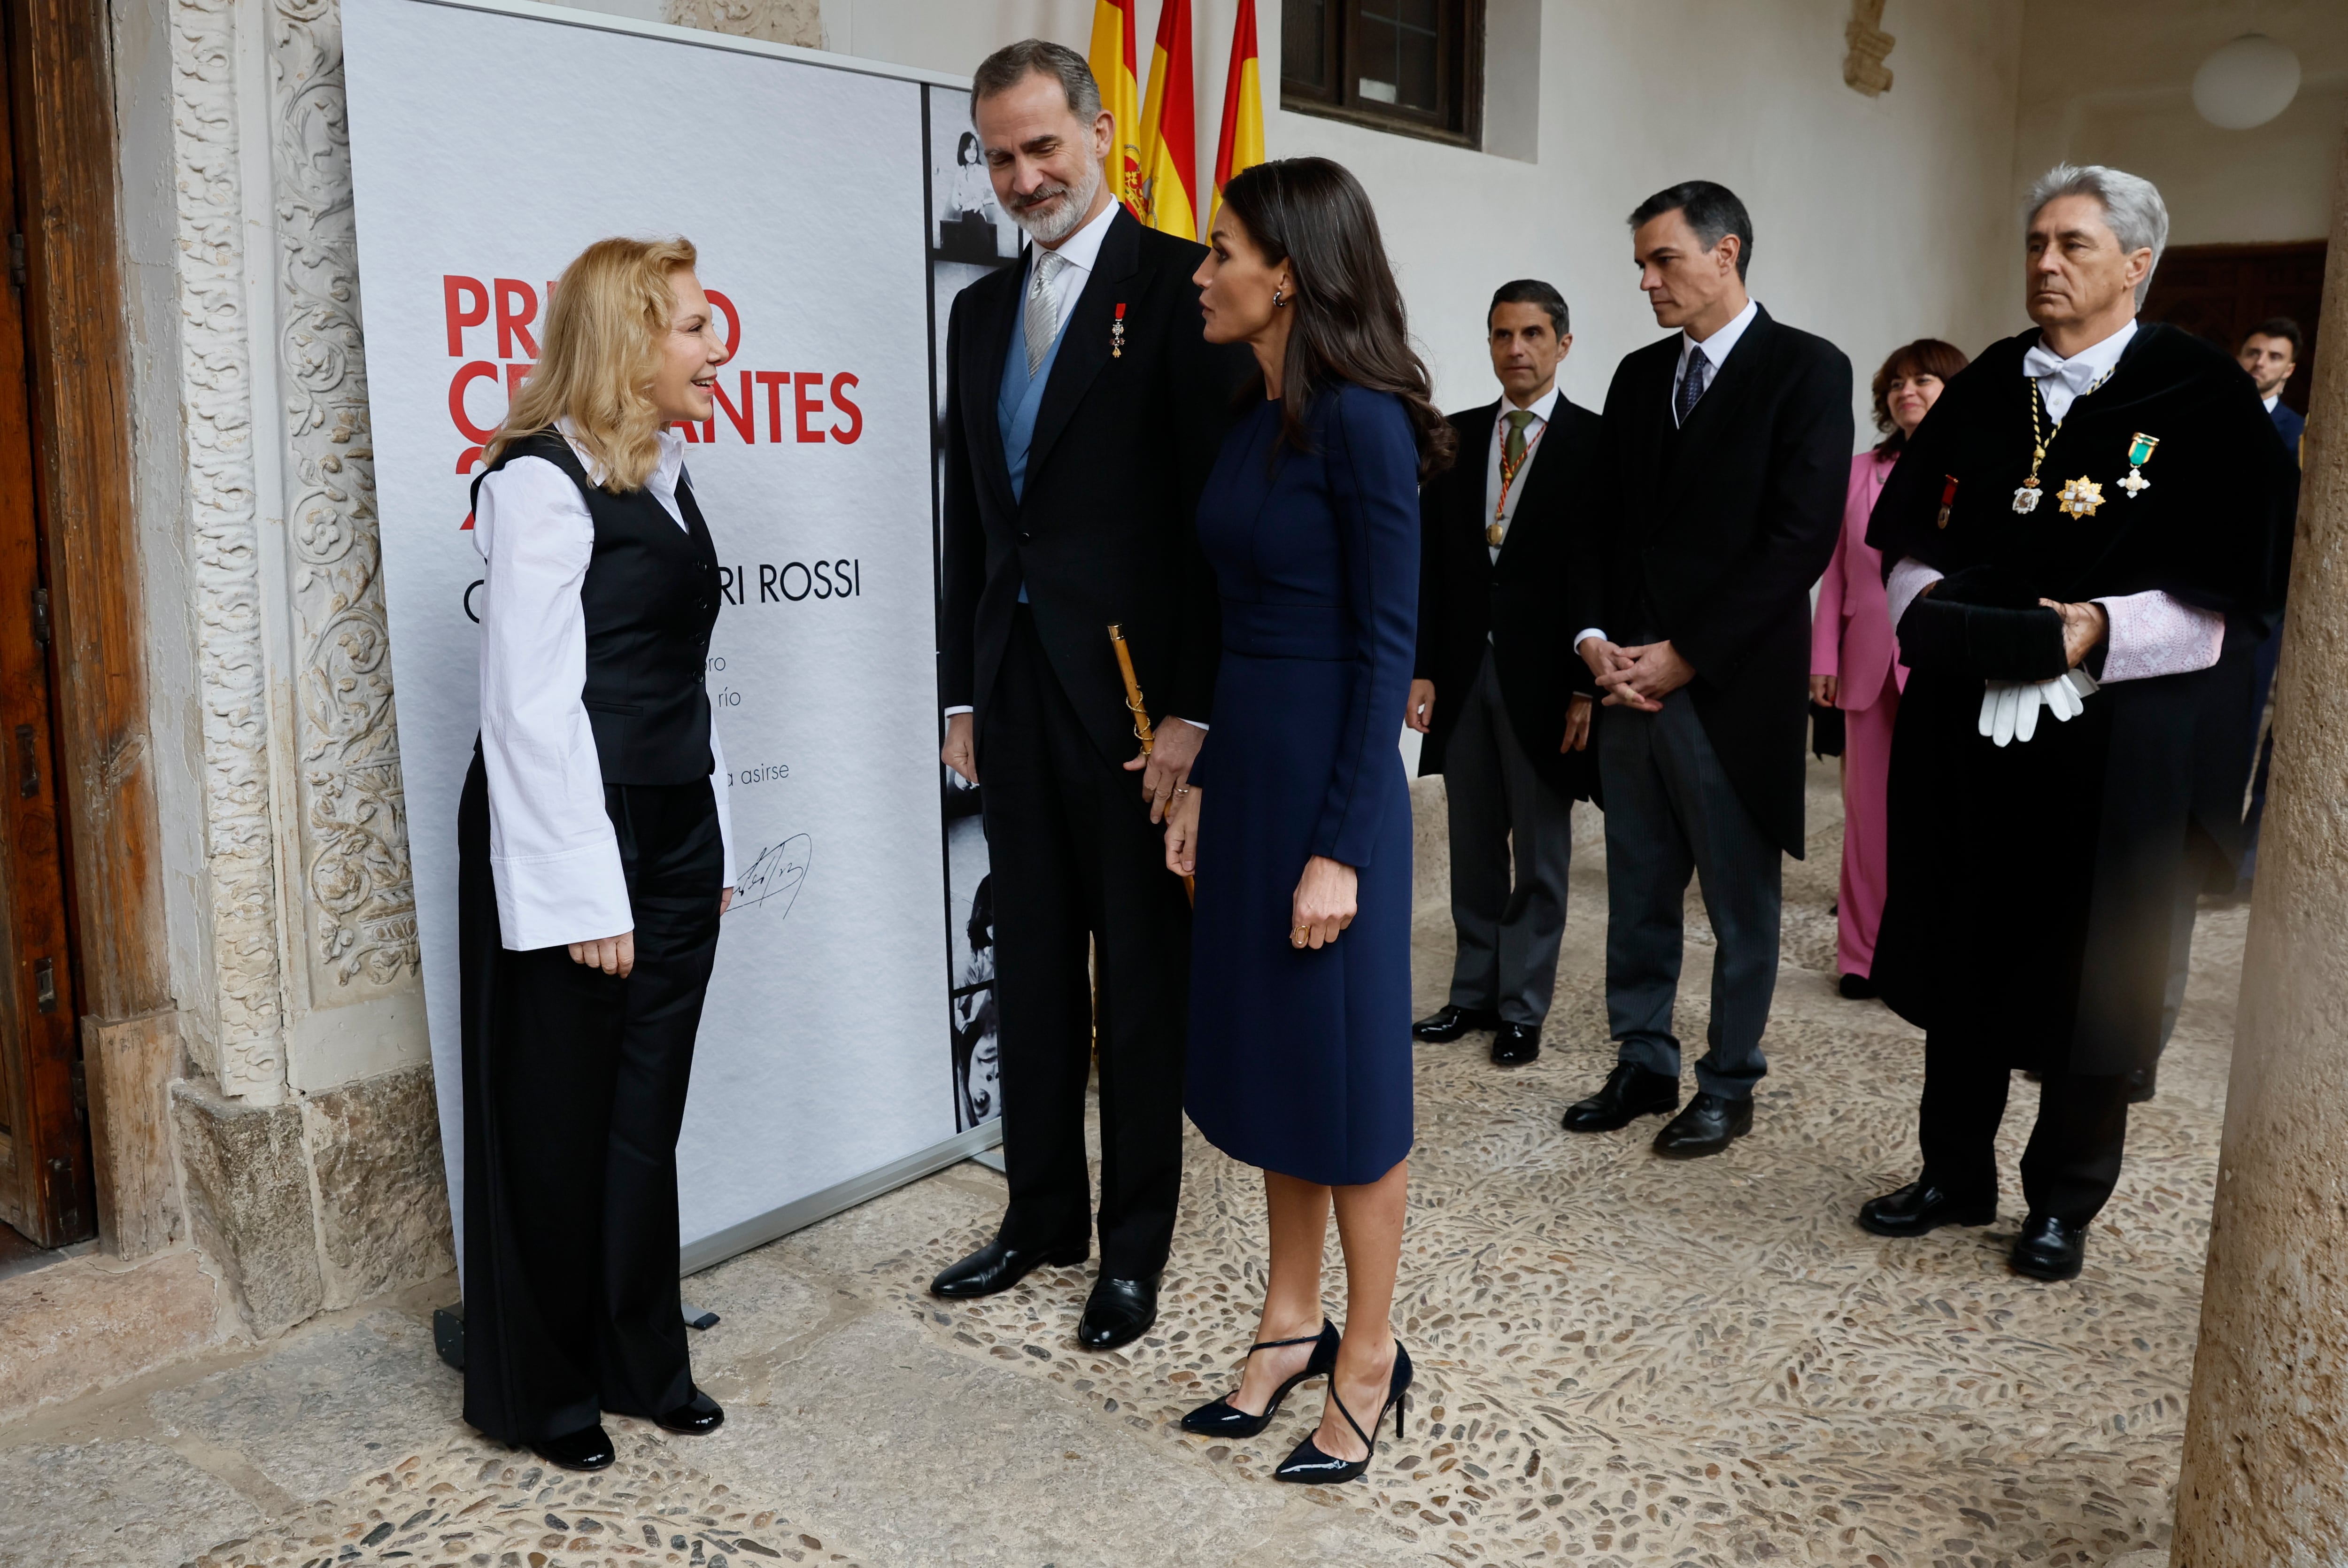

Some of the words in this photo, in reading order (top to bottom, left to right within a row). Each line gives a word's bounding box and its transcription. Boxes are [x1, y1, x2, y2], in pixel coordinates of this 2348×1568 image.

[444, 275, 741, 366] PRO
[759, 559, 860, 603] ROSSI
[719, 687, 741, 707] río
[741, 763, 789, 784] asirse
